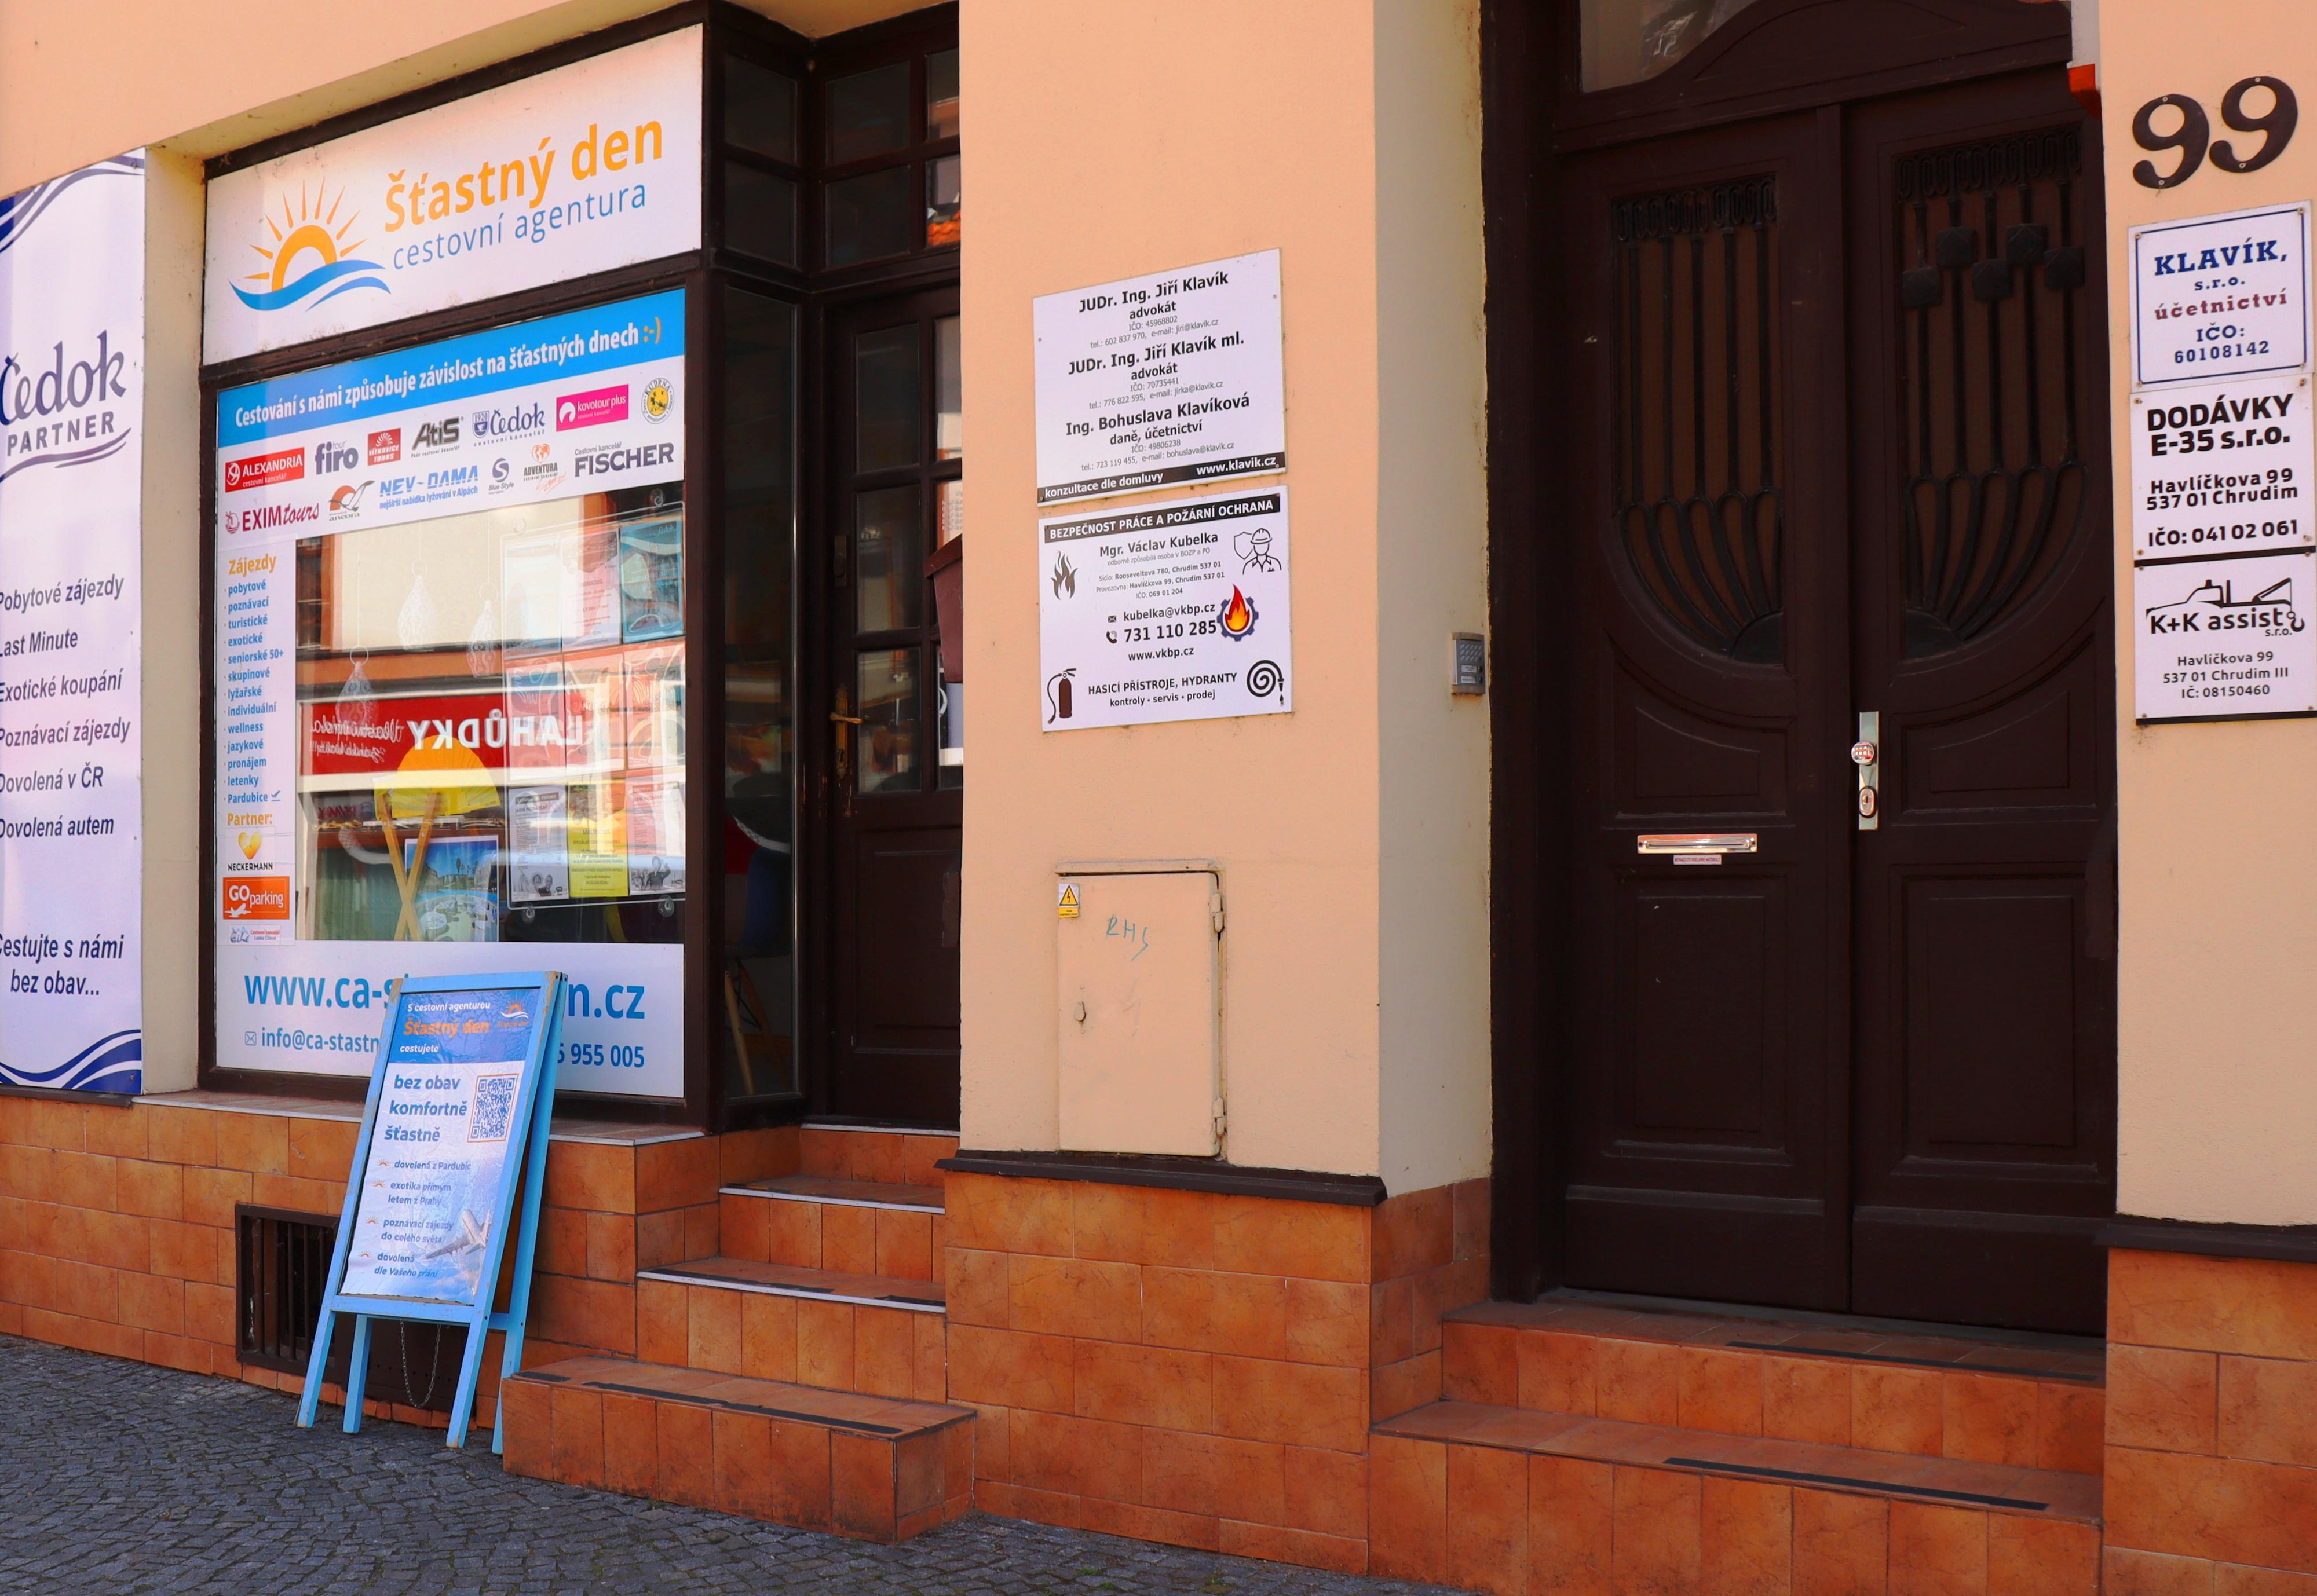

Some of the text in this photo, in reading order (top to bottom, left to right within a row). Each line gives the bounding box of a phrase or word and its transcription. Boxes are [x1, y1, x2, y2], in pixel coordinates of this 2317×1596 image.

[2132, 76, 2298, 189] 99
[385, 120, 662, 232] Šťastný den
[393, 184, 645, 269] cestovní agentura
[2154, 237, 2287, 276] KLAVÍK,
[1079, 271, 1229, 313] JUDr. Ing. Jiří Klavík
[2194, 277, 2245, 291] s.r.o.
[1129, 301, 1177, 320] advokát
[2154, 288, 2287, 320] účetnictví
[1145, 315, 1178, 328] 45968802
[2196, 322, 2245, 342] IČO:
[1068, 331, 1244, 375] JUDr. Ing. Jiří Klavík ml.
[2175, 340, 2269, 364] 60108142
[0, 329, 127, 426] Čedok
[235, 322, 638, 427] Cestování s námi způsobuje závislost na šťastných dnech
[1131, 362, 1178, 380] advokát
[490, 402, 546, 436] Čedok
[1066, 393, 1250, 436] Ing. Bohuslava Klavíková
[2147, 393, 2294, 431] DODÁVKY
[7, 411, 115, 456] PARTNER
[1110, 419, 1203, 446] daně, účetnictví
[2151, 426, 2290, 456] E-35 s.r.o.
[242, 453, 303, 478] ALEXANDRIA
[315, 441, 359, 474] firo
[575, 442, 674, 478] FISCHER
[524, 462, 558, 477] ADVENTURA
[1044, 455, 1276, 499] konzultace dle domluvy www.klavik.cz
[2151, 468, 2293, 494] Havlíčkova 99
[2146, 485, 2298, 510] 537 01 Chrudim
[1050, 499, 1274, 540] BEZPEČNOST PRÁCE A POŽÁRNÍ OCHRANA
[2148, 519, 2297, 547] IČO: 041 02 061
[1099, 532, 1218, 558] Mgr. Václav Kubelka
[228, 553, 277, 578] Zájezdy
[65, 573, 124, 605] zájezdy
[228, 579, 266, 597] pobytové
[1130, 577, 1163, 590] Havlíčkova
[1175, 573, 1202, 584] Chrudim
[1203, 572, 1215, 581] 537
[228, 596, 269, 614] poznávací
[1123, 603, 1216, 622] kubelka@vkbp.cz
[228, 614, 268, 629] turistické
[2151, 607, 2283, 634] K+K assist
[29, 628, 78, 653] Minute
[228, 632, 263, 647] exotické
[1124, 620, 1217, 643] 731 110 285
[2265, 628, 2292, 637] s.r.o.
[228, 648, 284, 664] seniorské 50+
[1128, 646, 1194, 662] www.vkbp.cz
[2177, 651, 2274, 667] Havlíčkova 99
[60, 667, 124, 699] koupání
[228, 667, 271, 683] skupinové
[1088, 672, 1238, 695] HASICÍ PŘÍSTROJE, HYDRANTY
[2163, 668, 2270, 683] 537 01 Chrudim
[228, 685, 262, 702] lyžařské
[1109, 689, 1216, 707] kontroly servis prodej
[2181, 684, 2270, 699] IČ: 08150460
[228, 701, 277, 717] individuální
[72, 716, 131, 746] zájezdy
[228, 722, 264, 734] wellness
[227, 738, 264, 754] jazykové
[228, 757, 266, 771] pronájem
[68, 761, 104, 789] v ČR
[228, 775, 259, 788] letenky
[228, 792, 268, 804] Pardubice
[67, 815, 114, 836] autem
[227, 812, 273, 826] Partner:
[228, 862, 273, 872] NECKERMANN
[63, 934, 125, 959] s námi
[10, 969, 100, 995] bez obav...
[407, 1002, 491, 1012] S cestovní agenturou
[403, 1017, 459, 1038] Šťastný
[461, 1019, 491, 1034] den
[400, 1044, 439, 1055] cestujete
[571, 1043, 604, 1066] 955
[610, 1045, 645, 1068] 005
[393, 1074, 461, 1090] bez obav
[389, 1100, 467, 1116] komfortně
[383, 1125, 440, 1142] šťastně
[394, 1160, 472, 1170] dovolená Pardubic
[390, 1181, 421, 1191] exotika
[388, 1195, 442, 1208] letem Prahy
[383, 1217, 425, 1229] poznávací
[381, 1232, 421, 1243] do celého
[377, 1252, 415, 1264] dovolená
[374, 1266, 416, 1277] dle Vašeho
